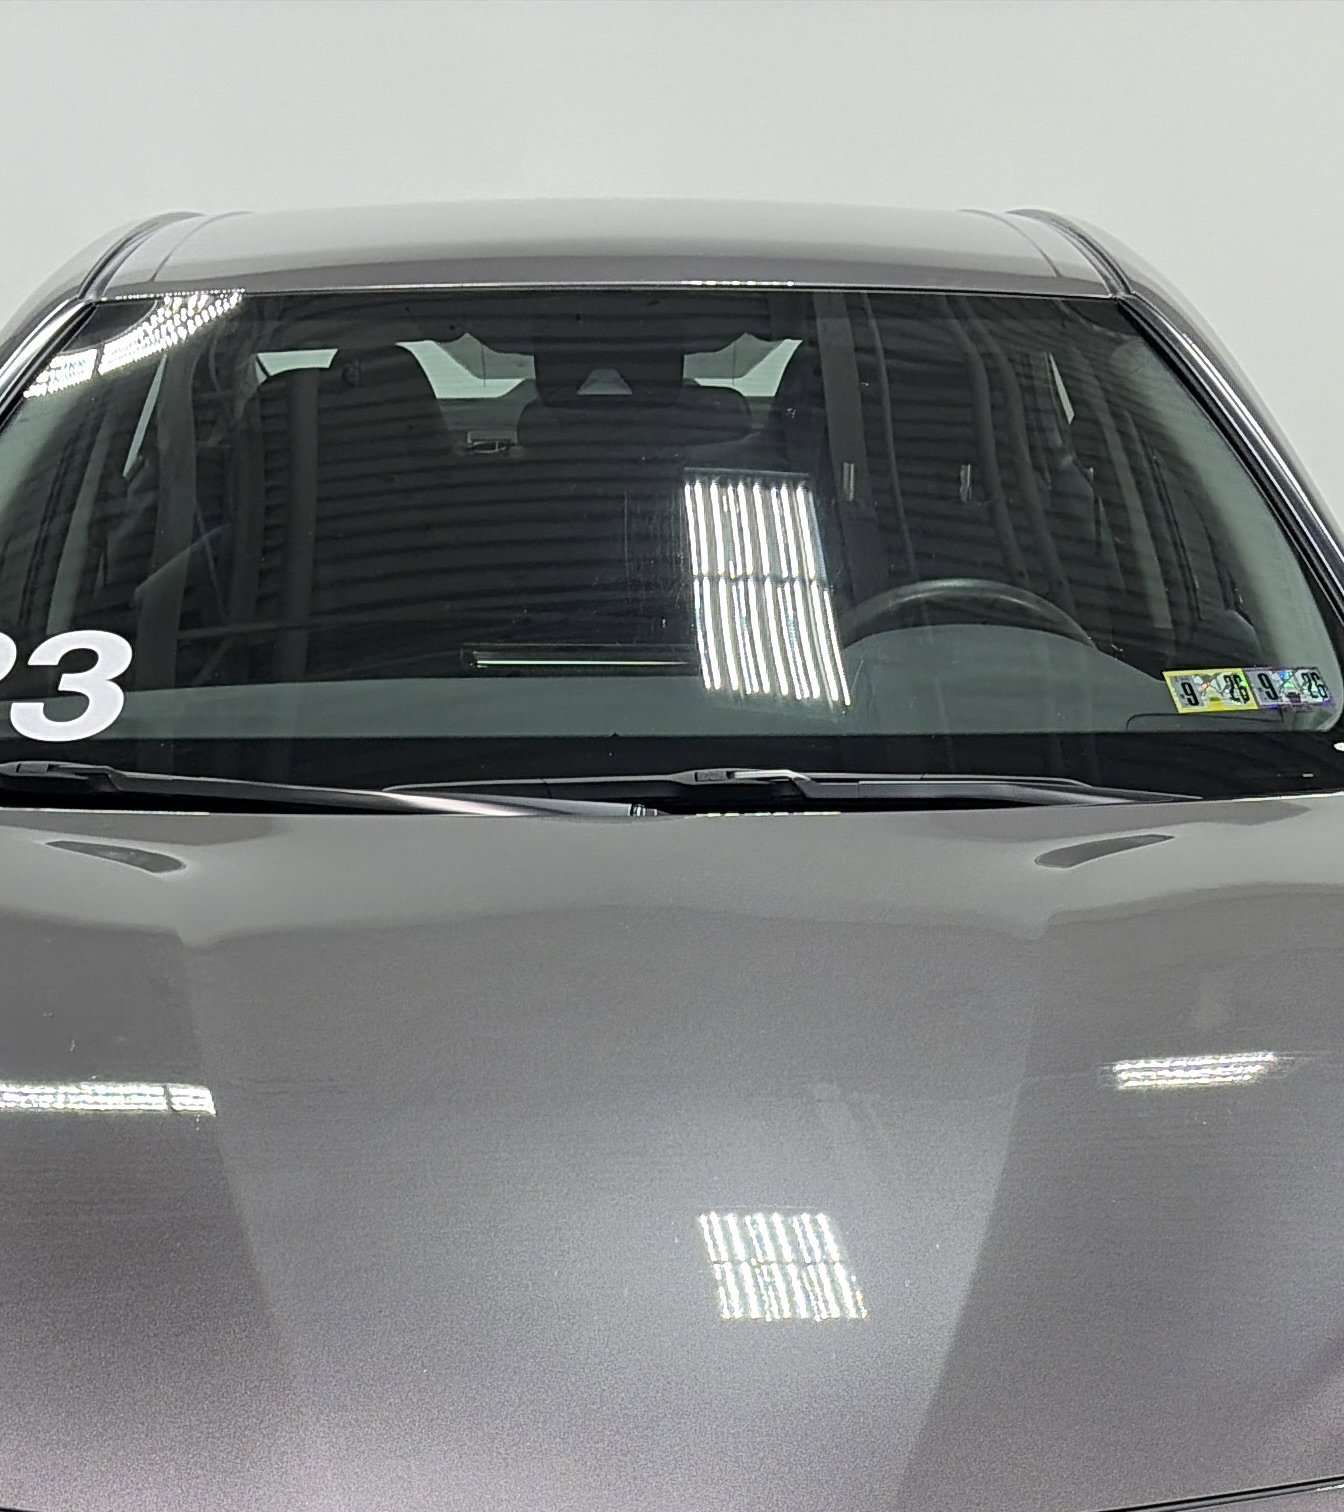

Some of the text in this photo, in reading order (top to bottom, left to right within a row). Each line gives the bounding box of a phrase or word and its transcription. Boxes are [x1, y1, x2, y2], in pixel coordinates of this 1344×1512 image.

[1181, 674, 1250, 706] 9 26
[1257, 672, 1328, 700] 9 26
